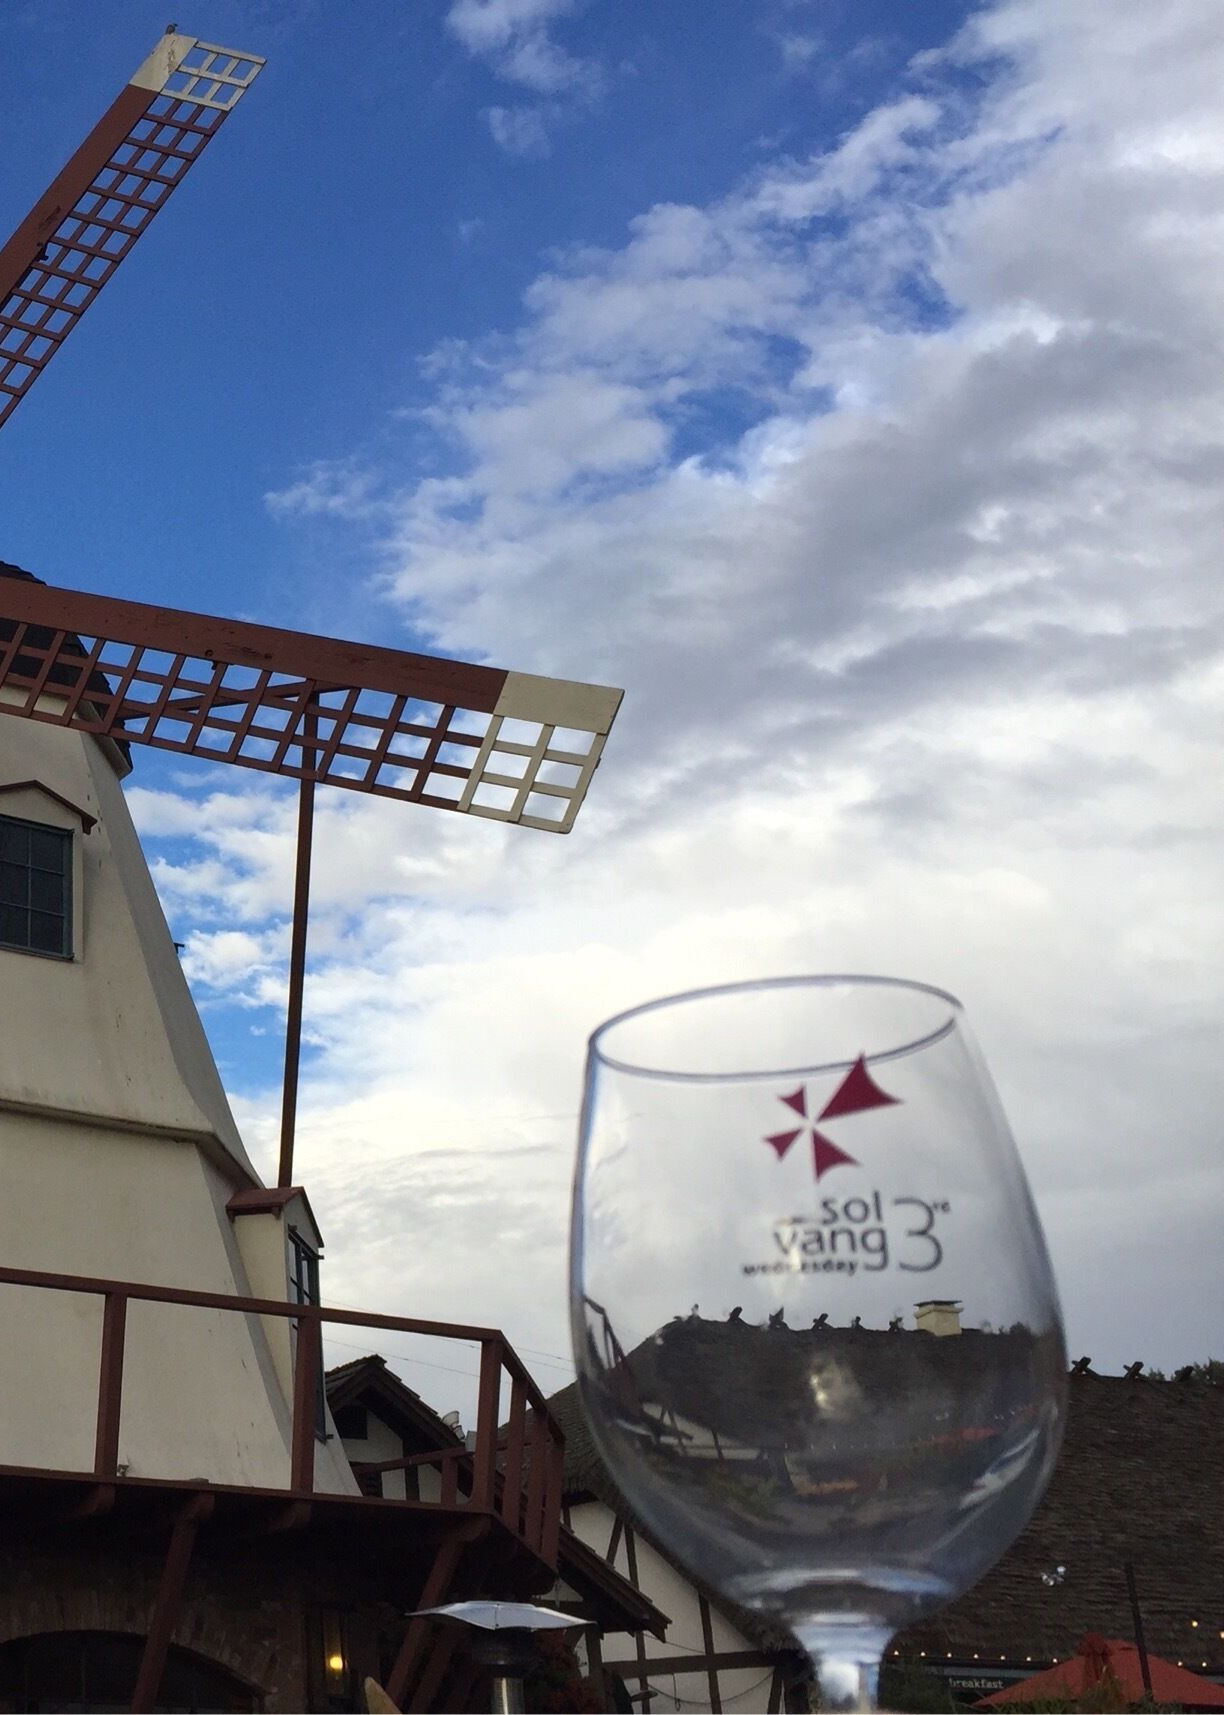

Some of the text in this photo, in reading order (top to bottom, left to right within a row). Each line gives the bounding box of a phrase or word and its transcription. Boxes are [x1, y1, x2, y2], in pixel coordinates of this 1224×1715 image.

[820, 1190, 883, 1225] sol
[773, 1226, 890, 1272] vang
[741, 1258, 859, 1277] wedesday
[948, 1677, 1005, 1689] breakfast
